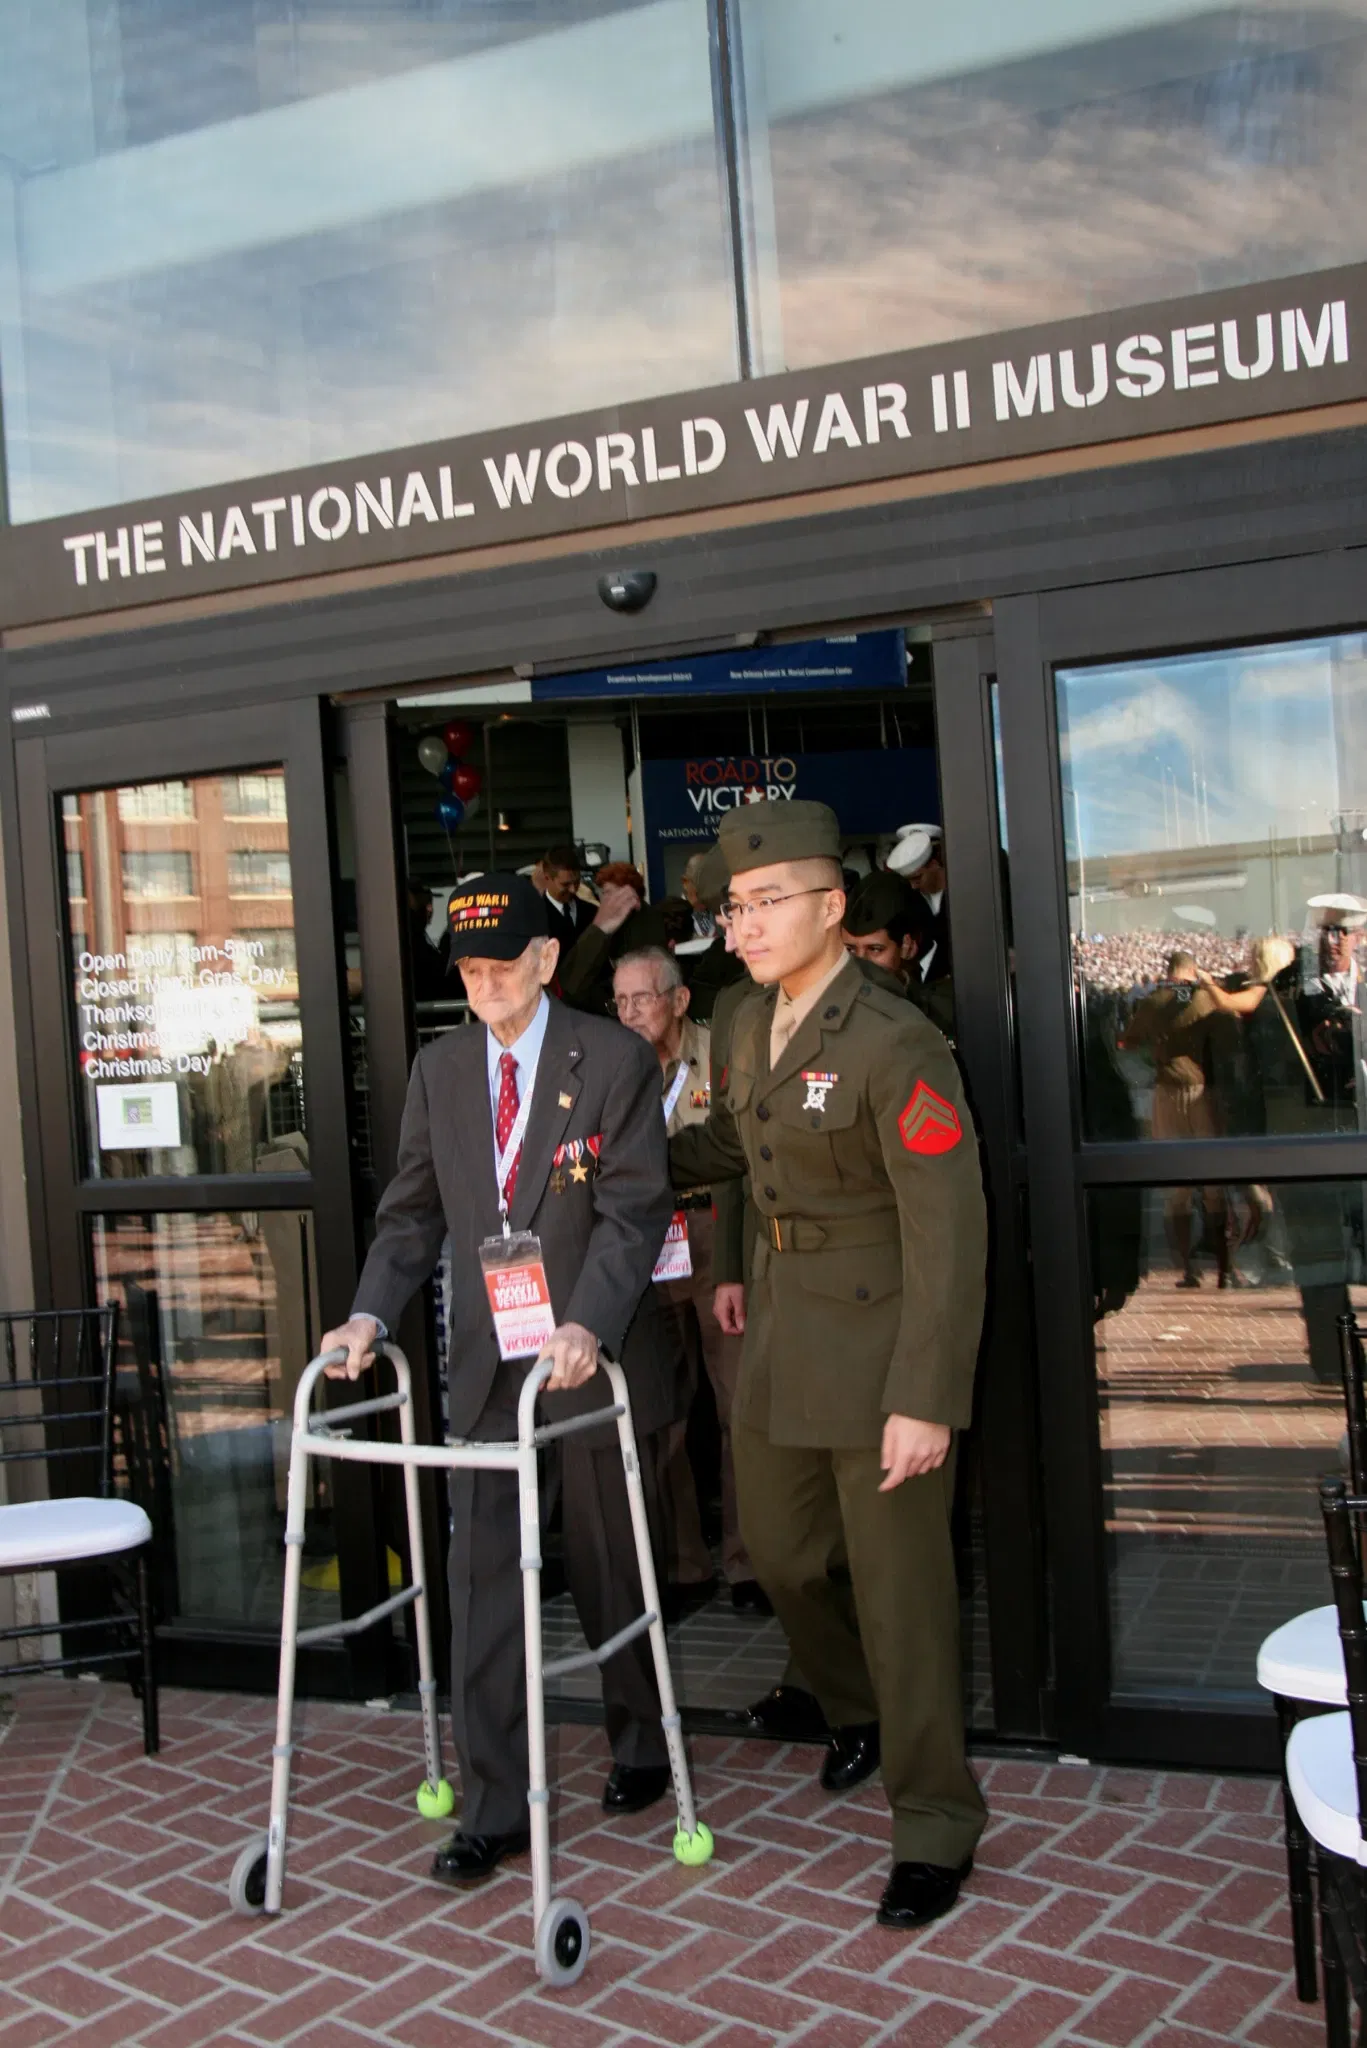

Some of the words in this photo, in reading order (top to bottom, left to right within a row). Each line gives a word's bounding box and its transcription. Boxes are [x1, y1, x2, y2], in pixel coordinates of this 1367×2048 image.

[64, 521, 166, 586] THE
[178, 466, 475, 566] NATIONAL
[483, 418, 727, 509] WORLD
[744, 382, 911, 463] WAR
[931, 369, 971, 433] II
[992, 300, 1349, 421] MUSEUM
[686, 758, 760, 785] ROAD
[760, 757, 797, 782] TO
[658, 827, 709, 838] NATIONAL
[449, 895, 474, 914] WORLD
[476, 893, 500, 907] WAR
[501, 894, 509, 907] II
[454, 918, 499, 933] VETERAN
[79, 952, 125, 976] Open
[130, 945, 174, 968] Daily
[79, 977, 140, 1000] Closed
[85, 1055, 172, 1079] Christmas
[176, 1051, 213, 1076] Day
